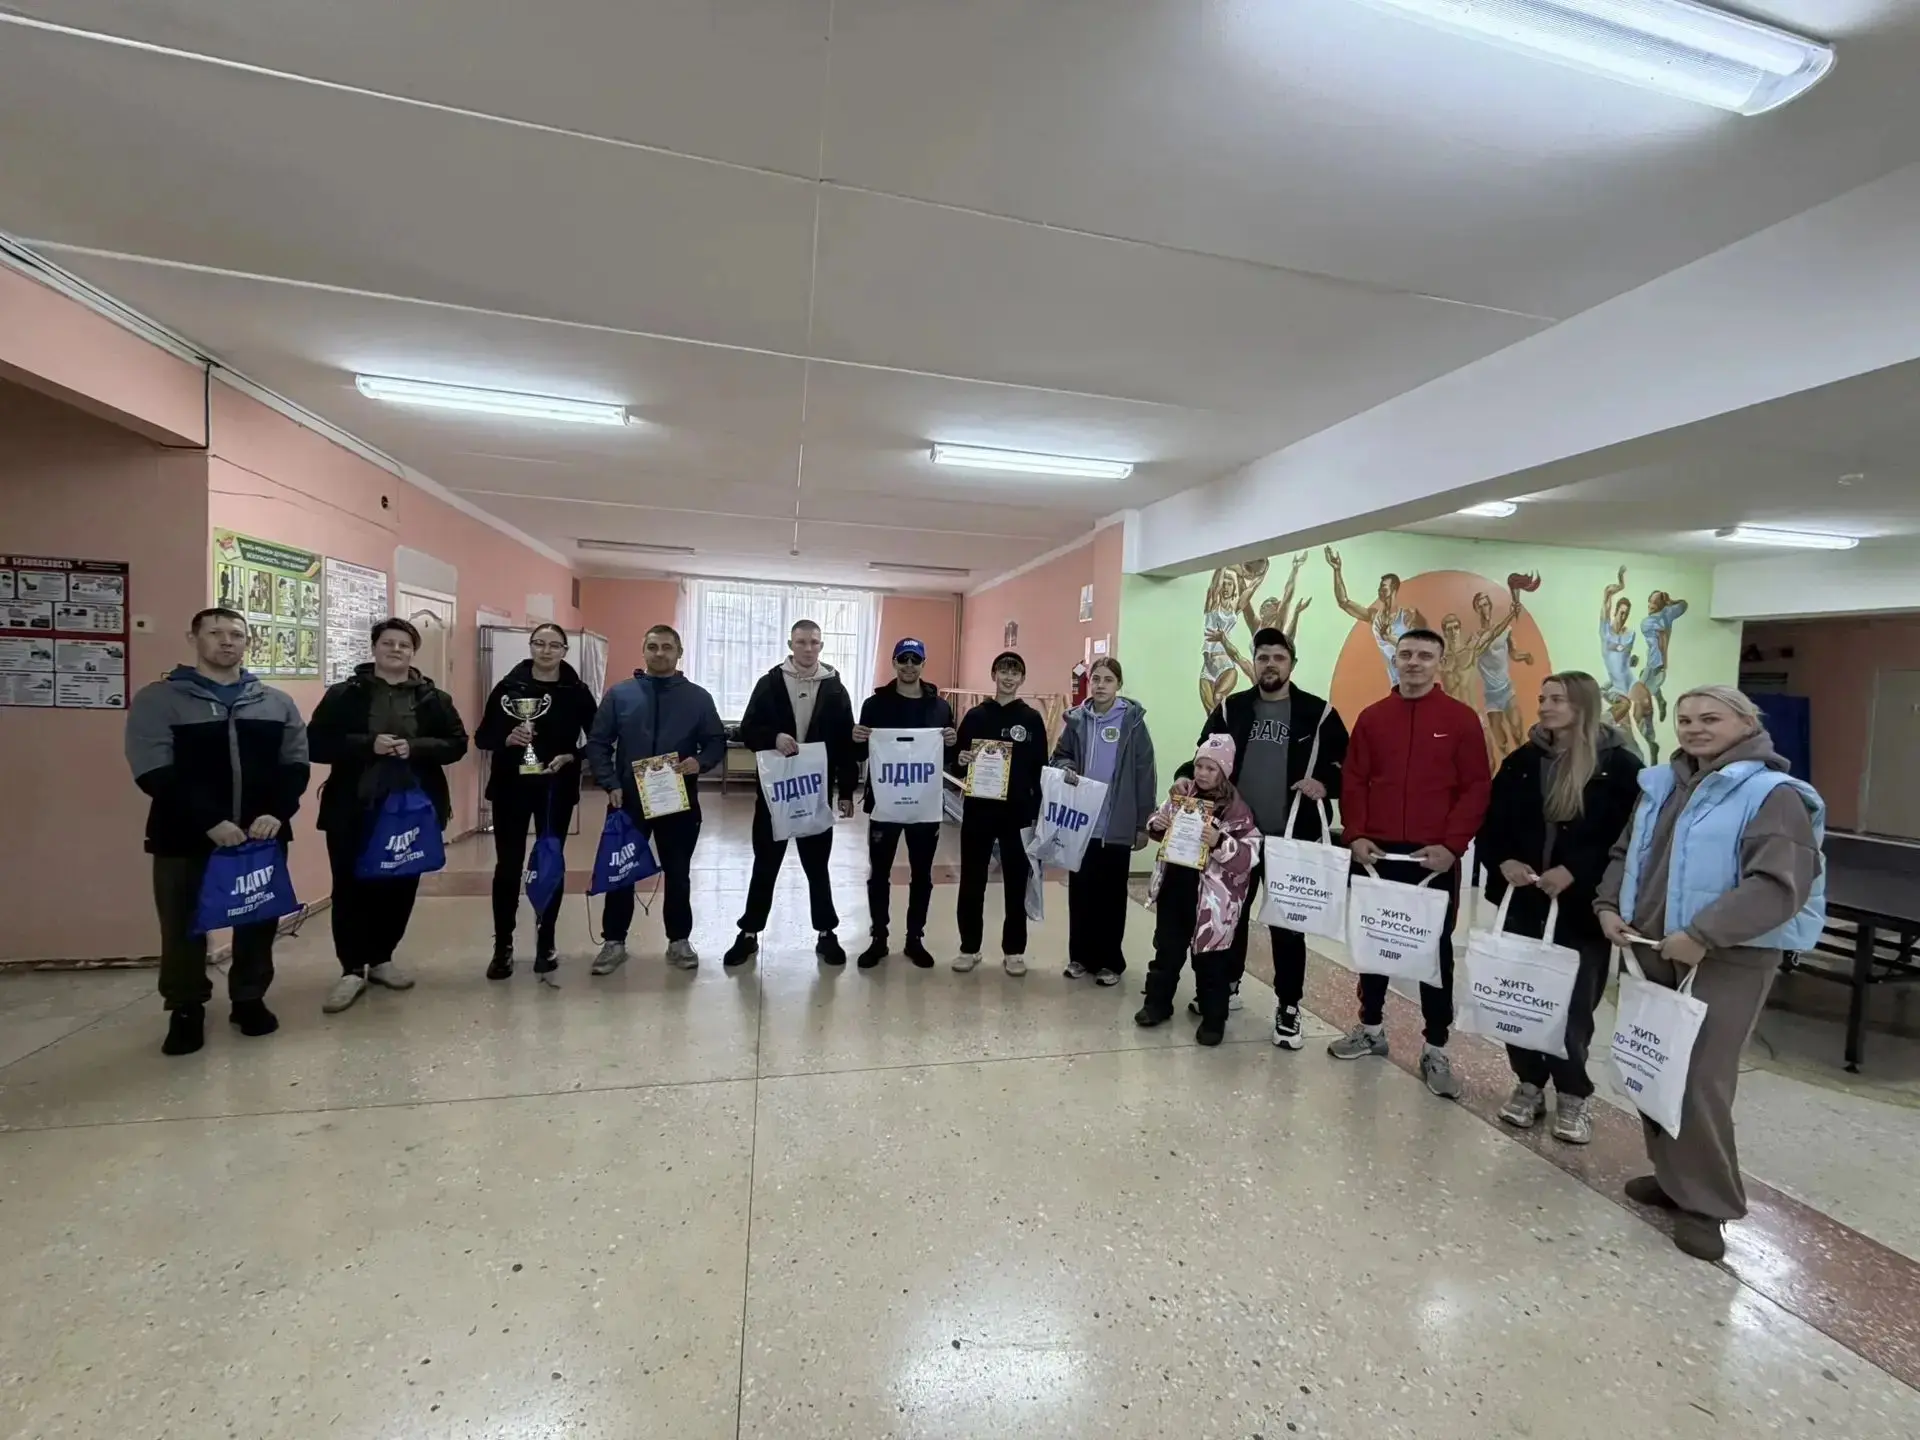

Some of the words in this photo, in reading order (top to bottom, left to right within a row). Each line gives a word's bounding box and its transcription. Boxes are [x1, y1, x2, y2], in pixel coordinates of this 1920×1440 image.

[878, 762, 935, 787] ЛДПР
[770, 773, 821, 803] ЛДПР
[1045, 801, 1089, 832] ЛДПР
[385, 826, 420, 852] ЛДПР
[230, 865, 274, 896] ЛДПР
[1286, 912, 1308, 922] ЛДПР
[1379, 948, 1402, 960] ЛДПР
[1495, 1021, 1523, 1034] ЛДПР
